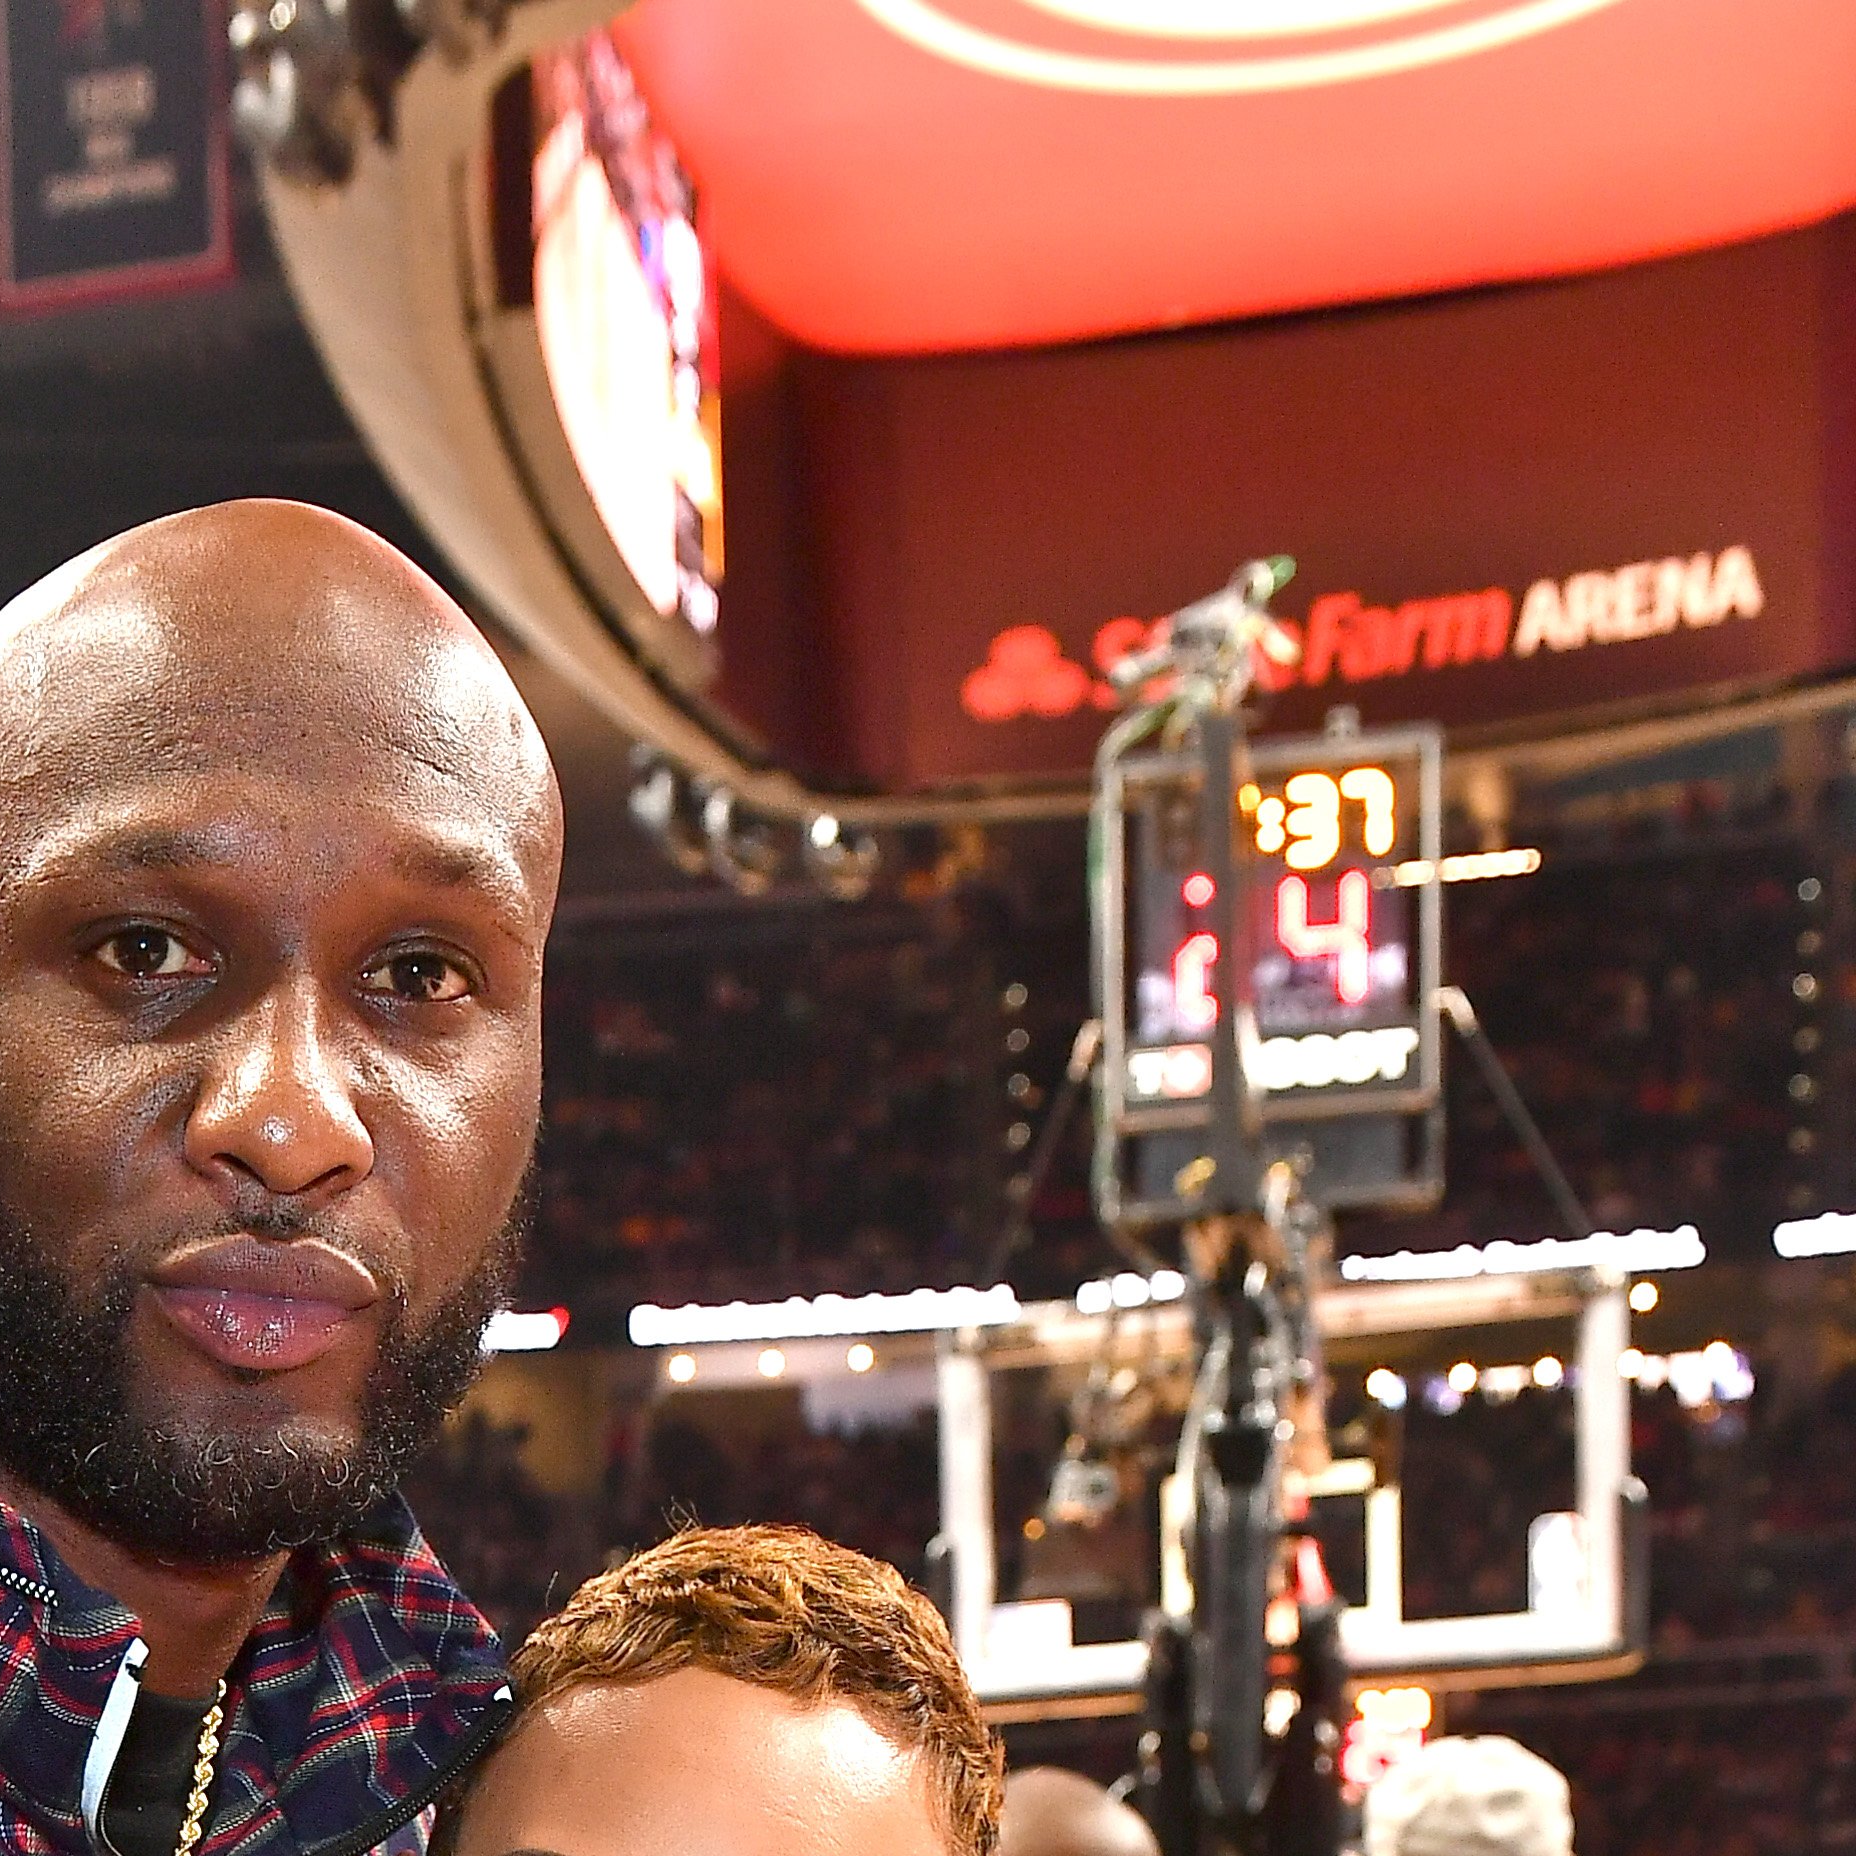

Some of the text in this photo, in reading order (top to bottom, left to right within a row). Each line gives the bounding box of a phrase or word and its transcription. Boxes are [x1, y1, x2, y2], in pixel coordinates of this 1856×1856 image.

[1304, 589, 1513, 685] Farm
[1514, 546, 1763, 656] ARENA
[1238, 766, 1396, 870] :37
